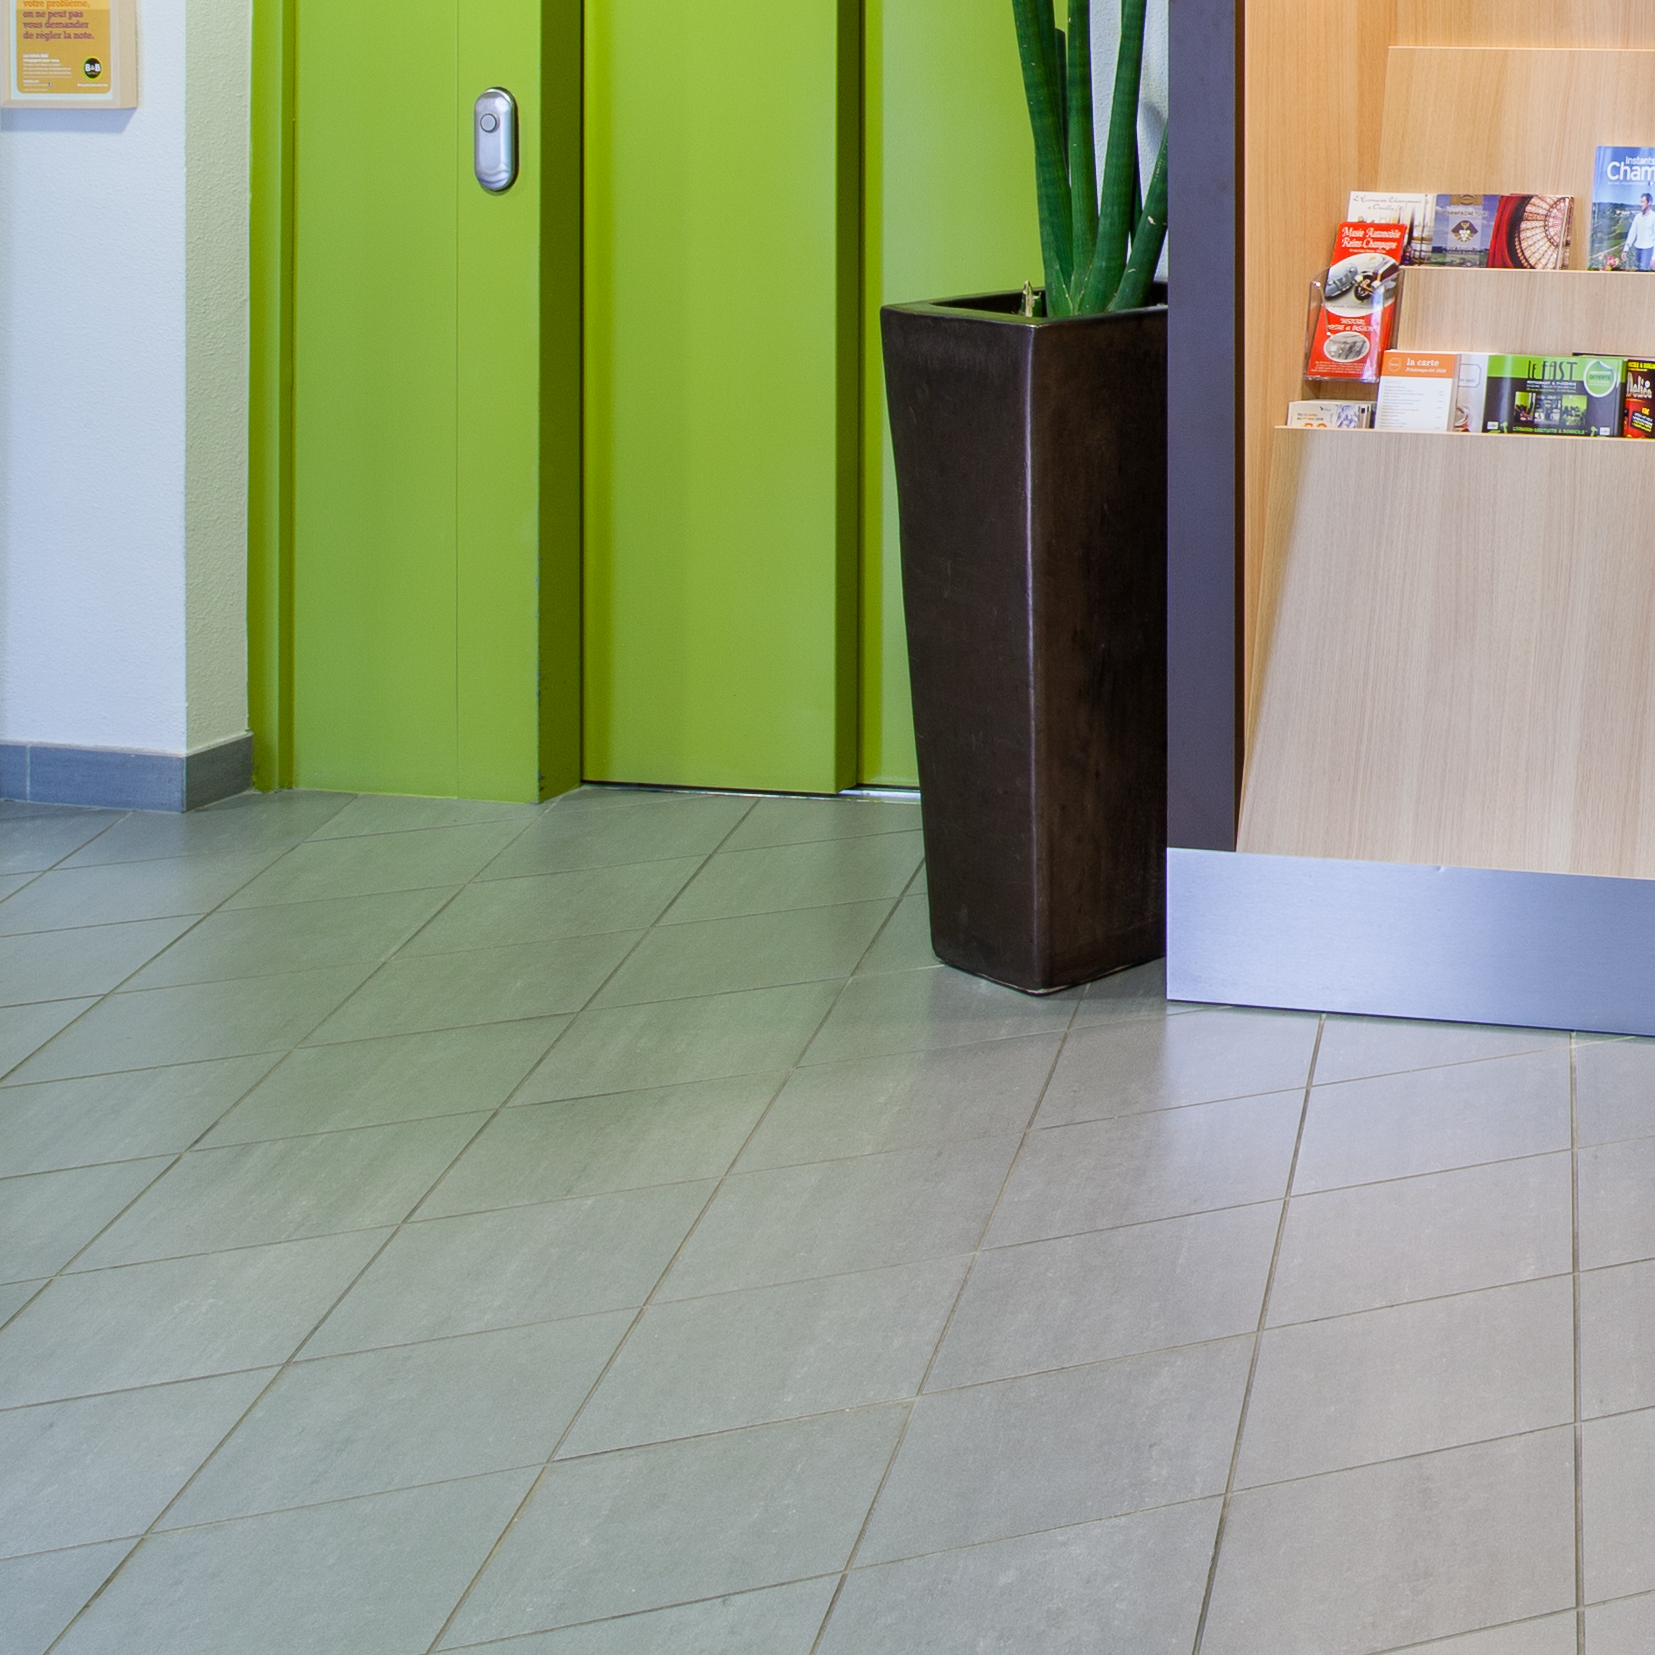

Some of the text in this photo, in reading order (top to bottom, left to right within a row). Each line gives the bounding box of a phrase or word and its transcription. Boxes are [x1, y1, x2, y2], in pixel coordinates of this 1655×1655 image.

[22, 30, 34, 40] de
[63, 30, 72, 40] la
[84, 63, 102, 72] B&B
[1406, 357, 1440, 367] la carte
[1541, 360, 1578, 381] FAST
